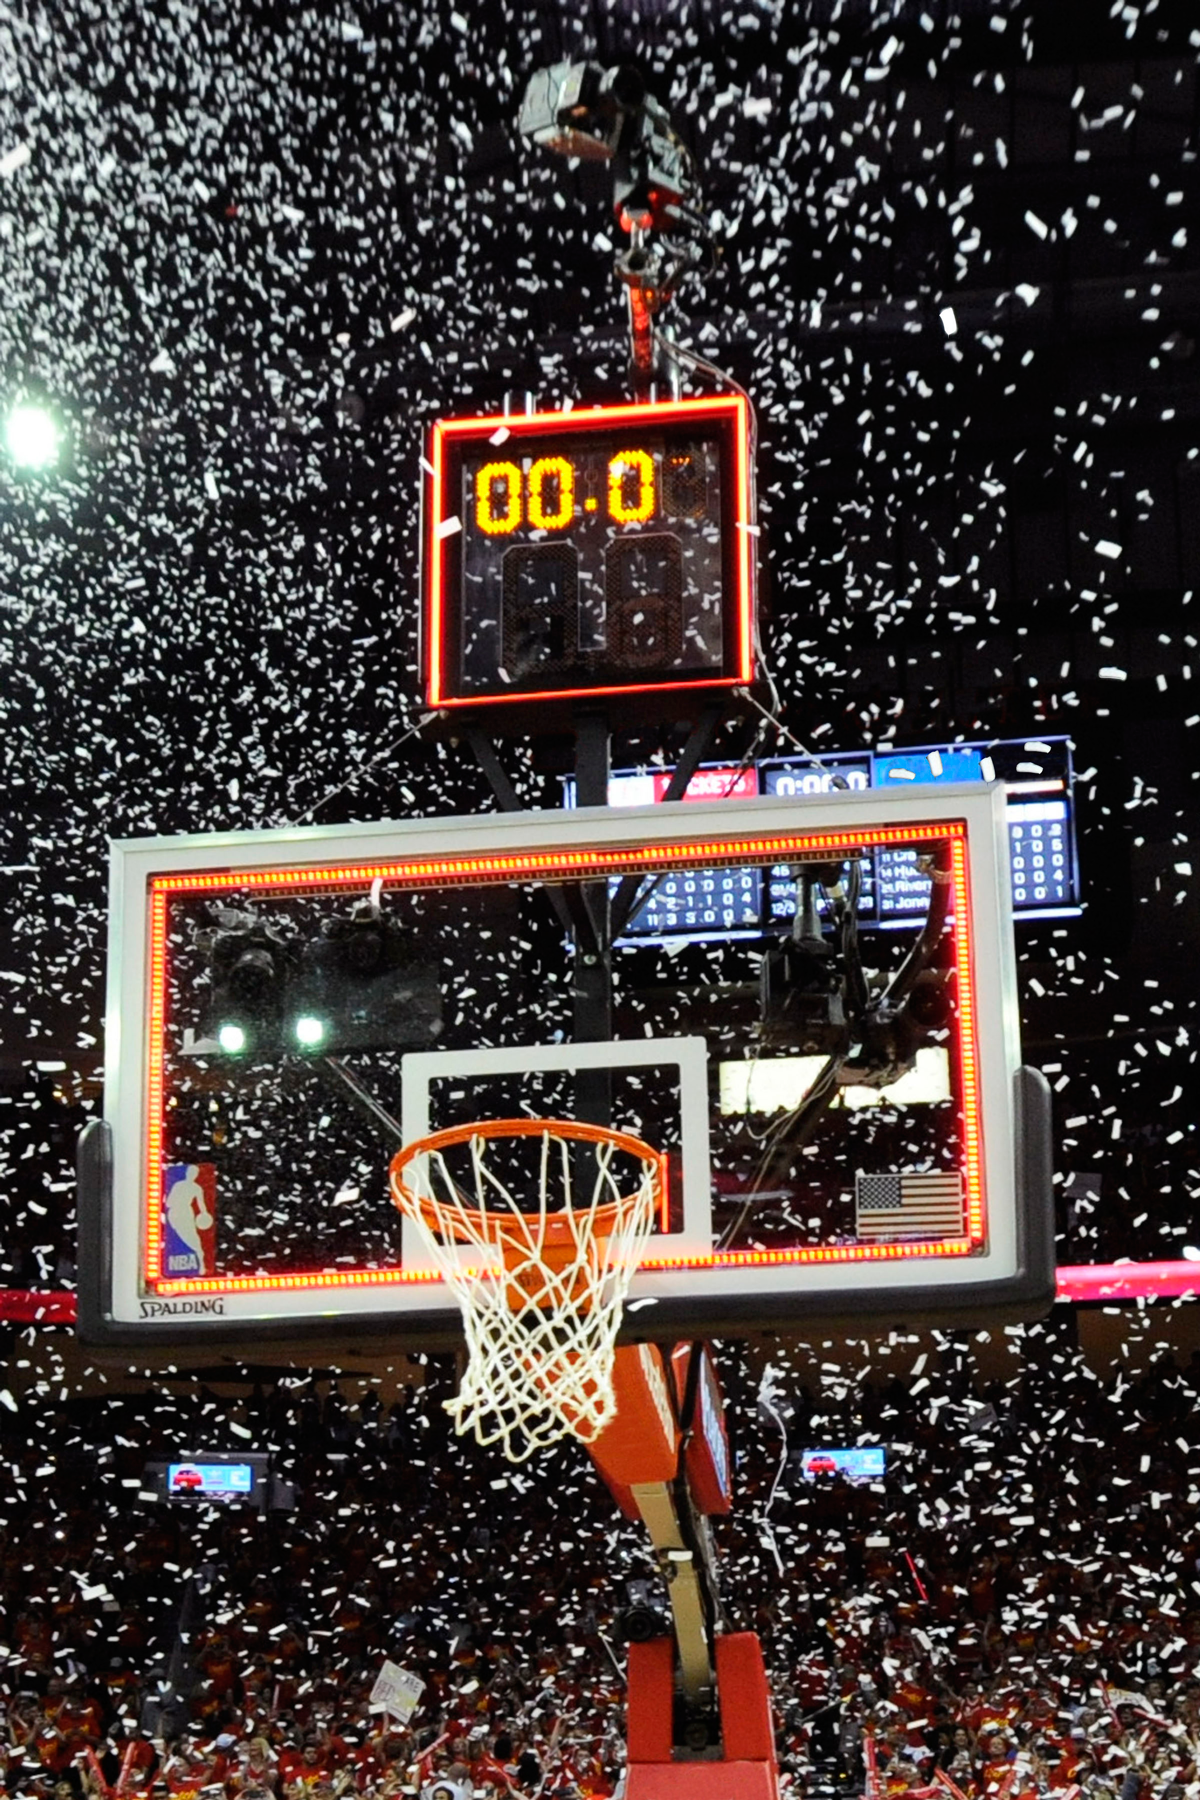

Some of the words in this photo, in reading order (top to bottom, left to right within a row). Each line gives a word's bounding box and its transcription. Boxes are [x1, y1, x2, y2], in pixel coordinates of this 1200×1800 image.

[475, 449, 655, 535] 00.0
[1031, 824, 1043, 838] 0
[1014, 841, 1021, 854] 1
[1032, 839, 1043, 853] 0
[1013, 856, 1025, 870] 0
[1033, 855, 1045, 868] 0
[1052, 853, 1064, 867] 0
[665, 882, 677, 895] 0
[684, 880, 696, 893] 0
[703, 879, 715, 892] 0
[722, 878, 733, 890] 0
[741, 876, 752, 889] 0
[1014, 871, 1026, 885] 0
[1033, 870, 1045, 883] 0
[1053, 870, 1064, 881] 4
[647, 898, 657, 910] 4
[687, 895, 694, 907] 1
[706, 894, 713, 906] 1
[722, 892, 734, 905] 0
[741, 891, 752, 904] 4
[1015, 888, 1027, 901] 0
[1034, 886, 1046, 900] 0
[1056, 885, 1063, 898] 1
[666, 912, 677, 926] 3
[703, 909, 716, 923] 0
[722, 908, 734, 921] 0
[168, 1254, 198, 1271] NBA
[139, 1297, 224, 1320] SPALDING
